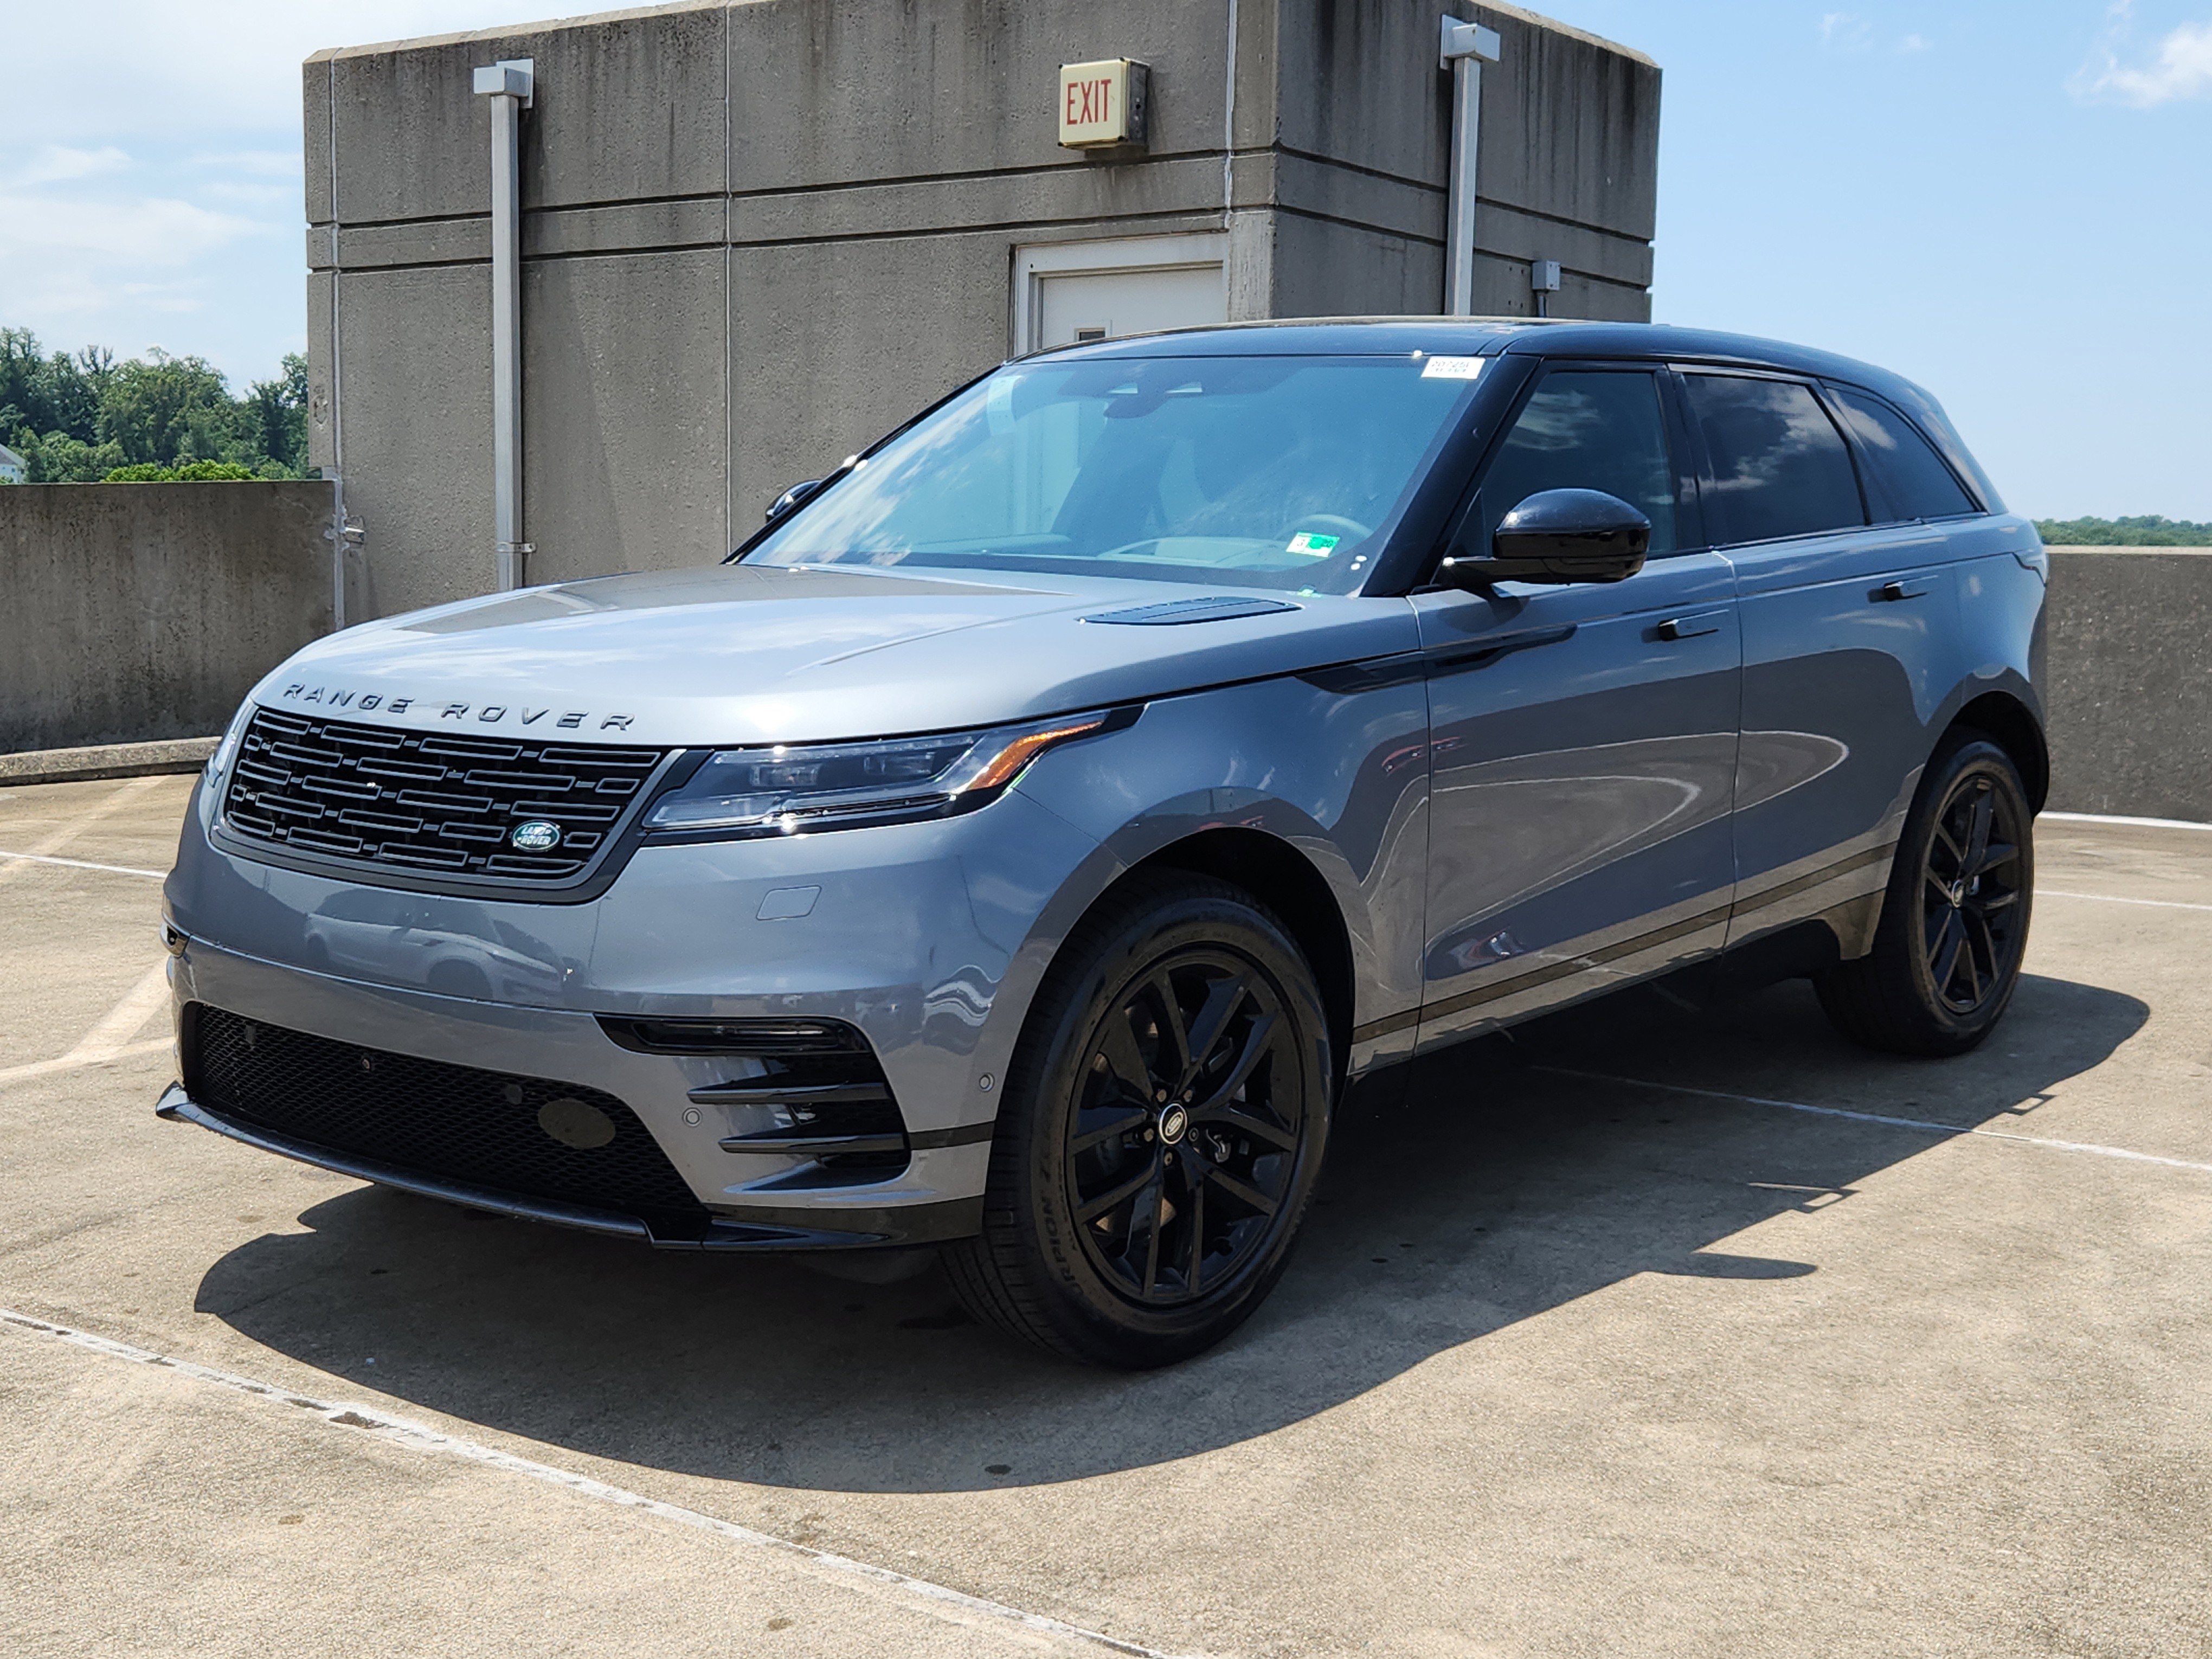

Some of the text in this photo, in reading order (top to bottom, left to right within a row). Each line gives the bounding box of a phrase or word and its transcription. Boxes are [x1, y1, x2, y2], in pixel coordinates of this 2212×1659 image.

[1067, 79, 1111, 125] EXIT
[283, 682, 635, 731] RANGE ROVER
